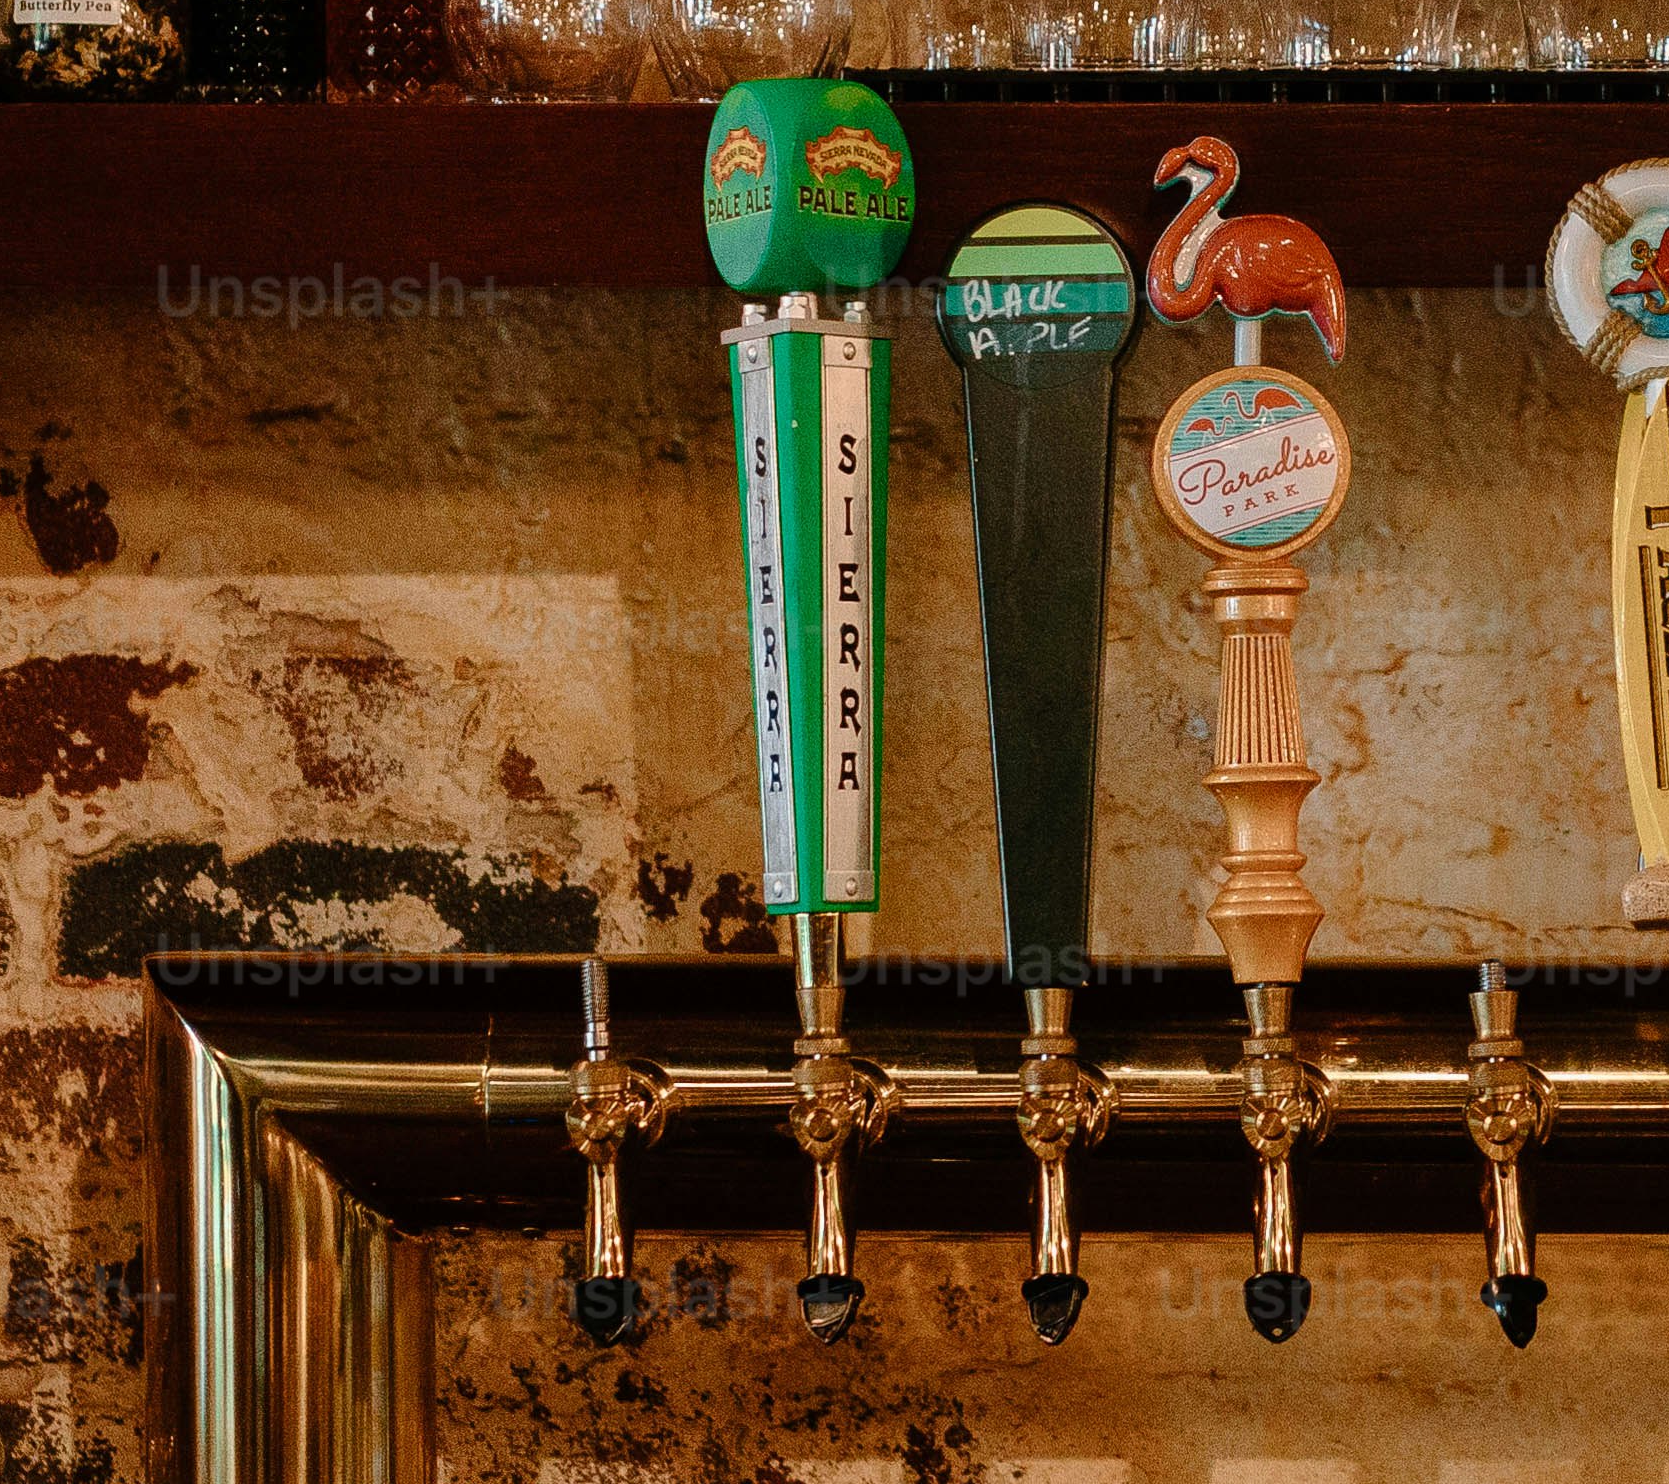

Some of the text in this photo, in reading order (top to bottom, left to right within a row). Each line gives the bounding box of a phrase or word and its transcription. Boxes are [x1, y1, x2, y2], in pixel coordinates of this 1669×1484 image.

[19, 0, 112, 13] Butterfly Pea
[819, 144, 889, 170] SIERRA NEVADA
[707, 185, 772, 224] PALE ALE
[798, 185, 910, 223] PALE ALE
[968, 316, 1093, 360] APLE
[1178, 436, 1336, 506] Paradise
[1222, 483, 1300, 518] PARK
[754, 436, 782, 794] SIERRA
[838, 433, 862, 791] SIERRA
